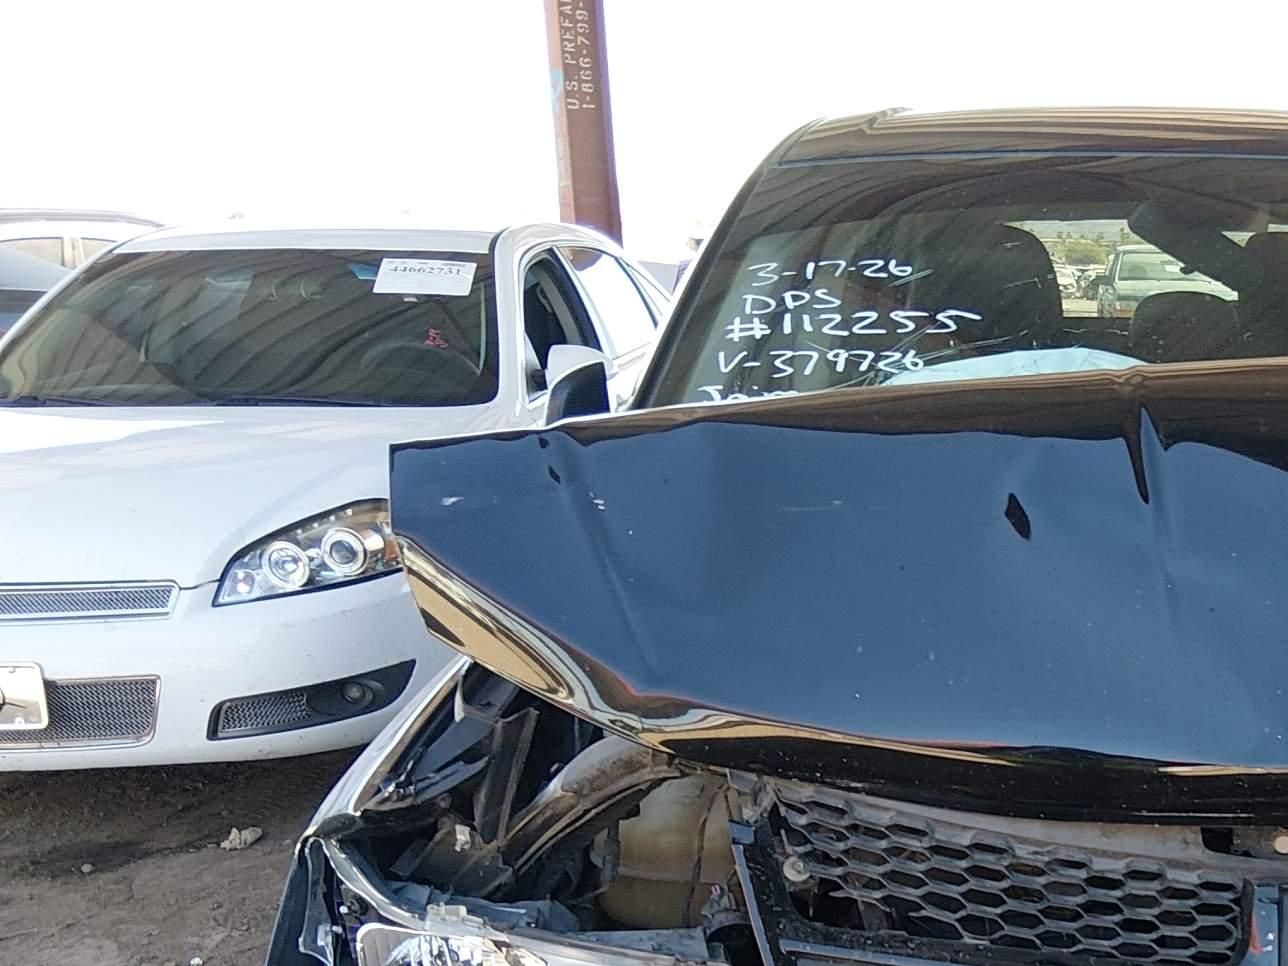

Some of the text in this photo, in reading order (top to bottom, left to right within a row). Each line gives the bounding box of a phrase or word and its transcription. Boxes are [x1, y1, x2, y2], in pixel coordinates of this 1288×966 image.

[566, 76, 580, 110] U.S.
[389, 266, 462, 275] 44662731
[747, 258, 913, 287] 3-17-26
[742, 288, 842, 315] DPS
[725, 309, 983, 341] #112255
